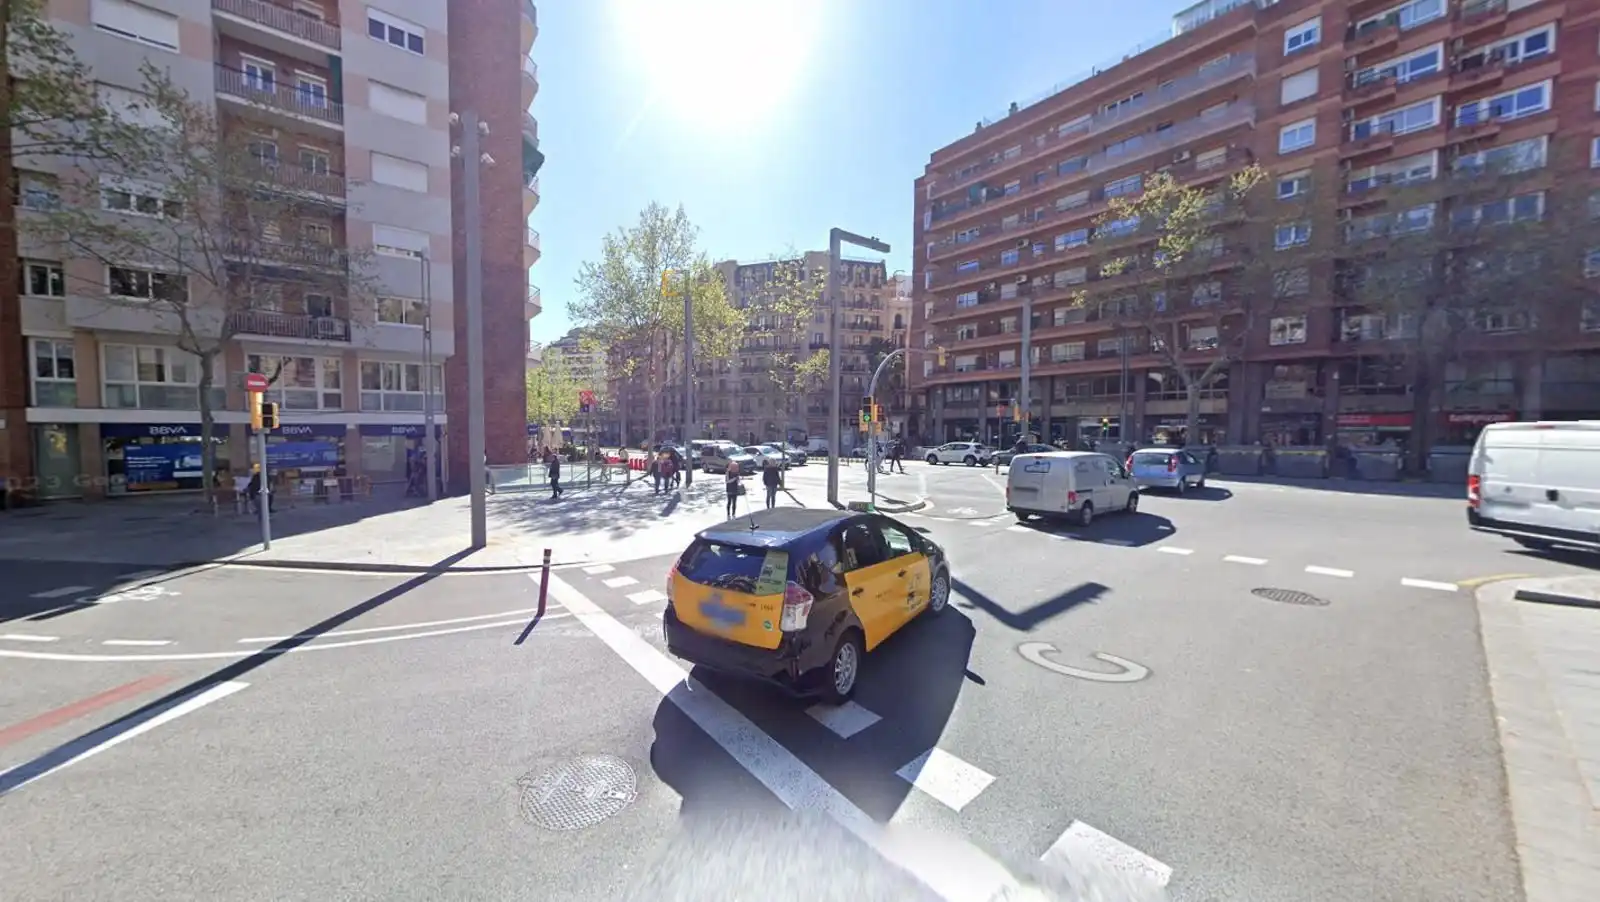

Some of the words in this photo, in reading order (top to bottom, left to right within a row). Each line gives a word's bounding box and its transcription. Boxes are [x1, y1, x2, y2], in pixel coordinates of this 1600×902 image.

[149, 426, 188, 435] BBVA
[282, 426, 313, 434] BBVA
[392, 426, 417, 434] BBVA
